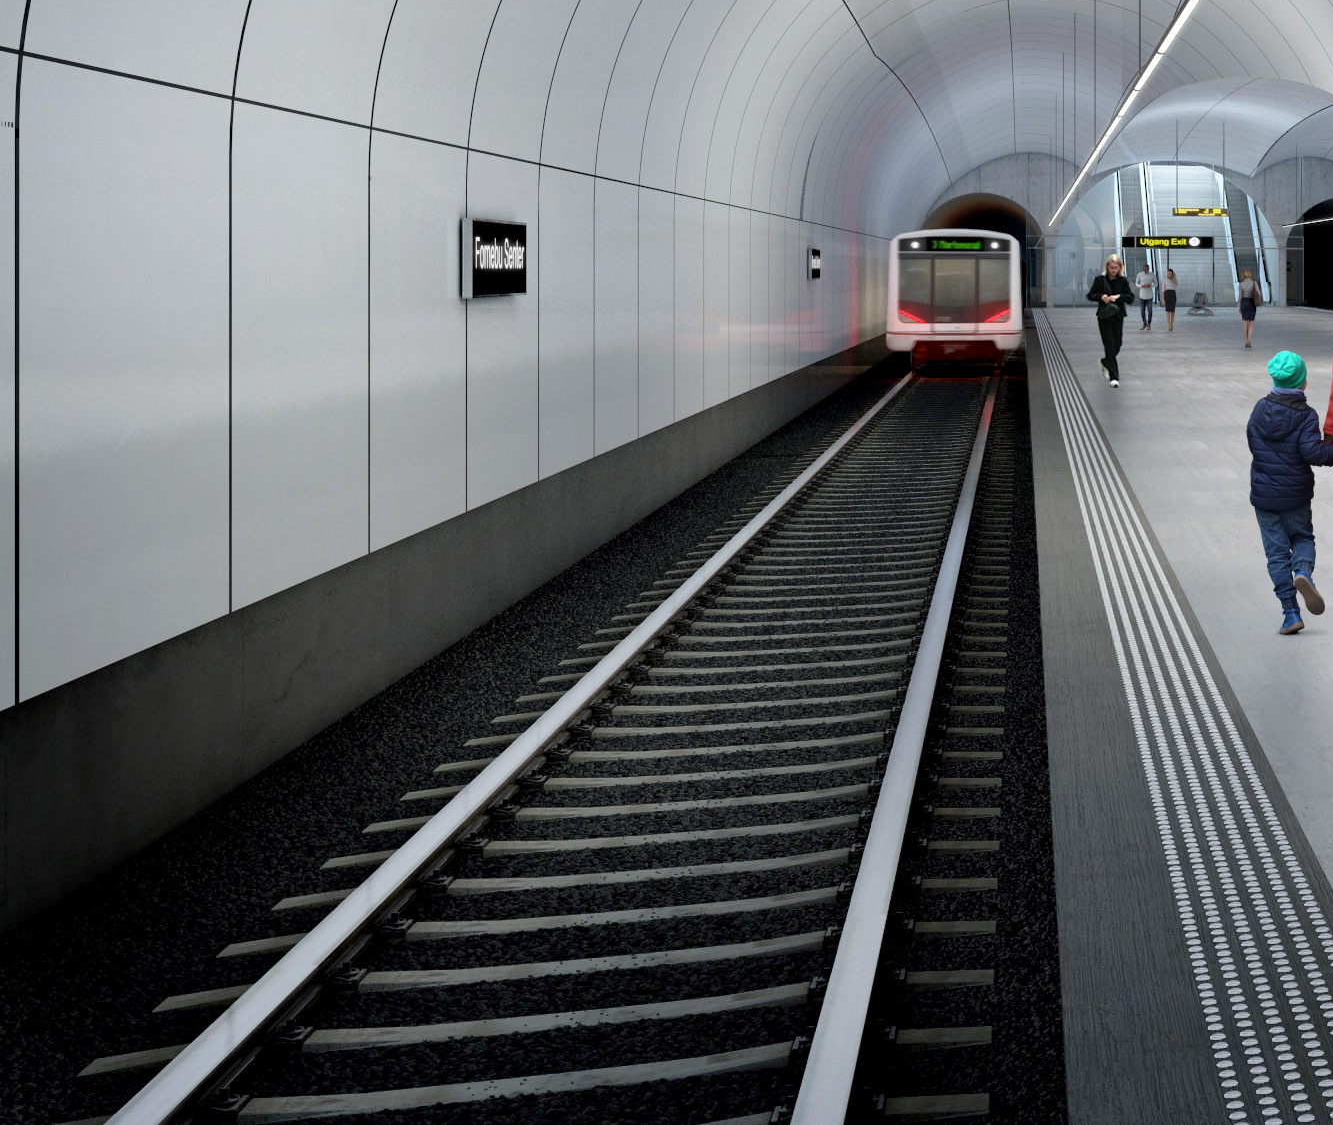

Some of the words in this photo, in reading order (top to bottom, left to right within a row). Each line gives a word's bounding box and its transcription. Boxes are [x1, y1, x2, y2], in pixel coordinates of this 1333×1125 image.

[474, 236, 503, 270] Fornebu
[504, 237, 525, 270] Senter
[1139, 237, 1170, 247] Utgang
[1171, 237, 1187, 246] Exit
